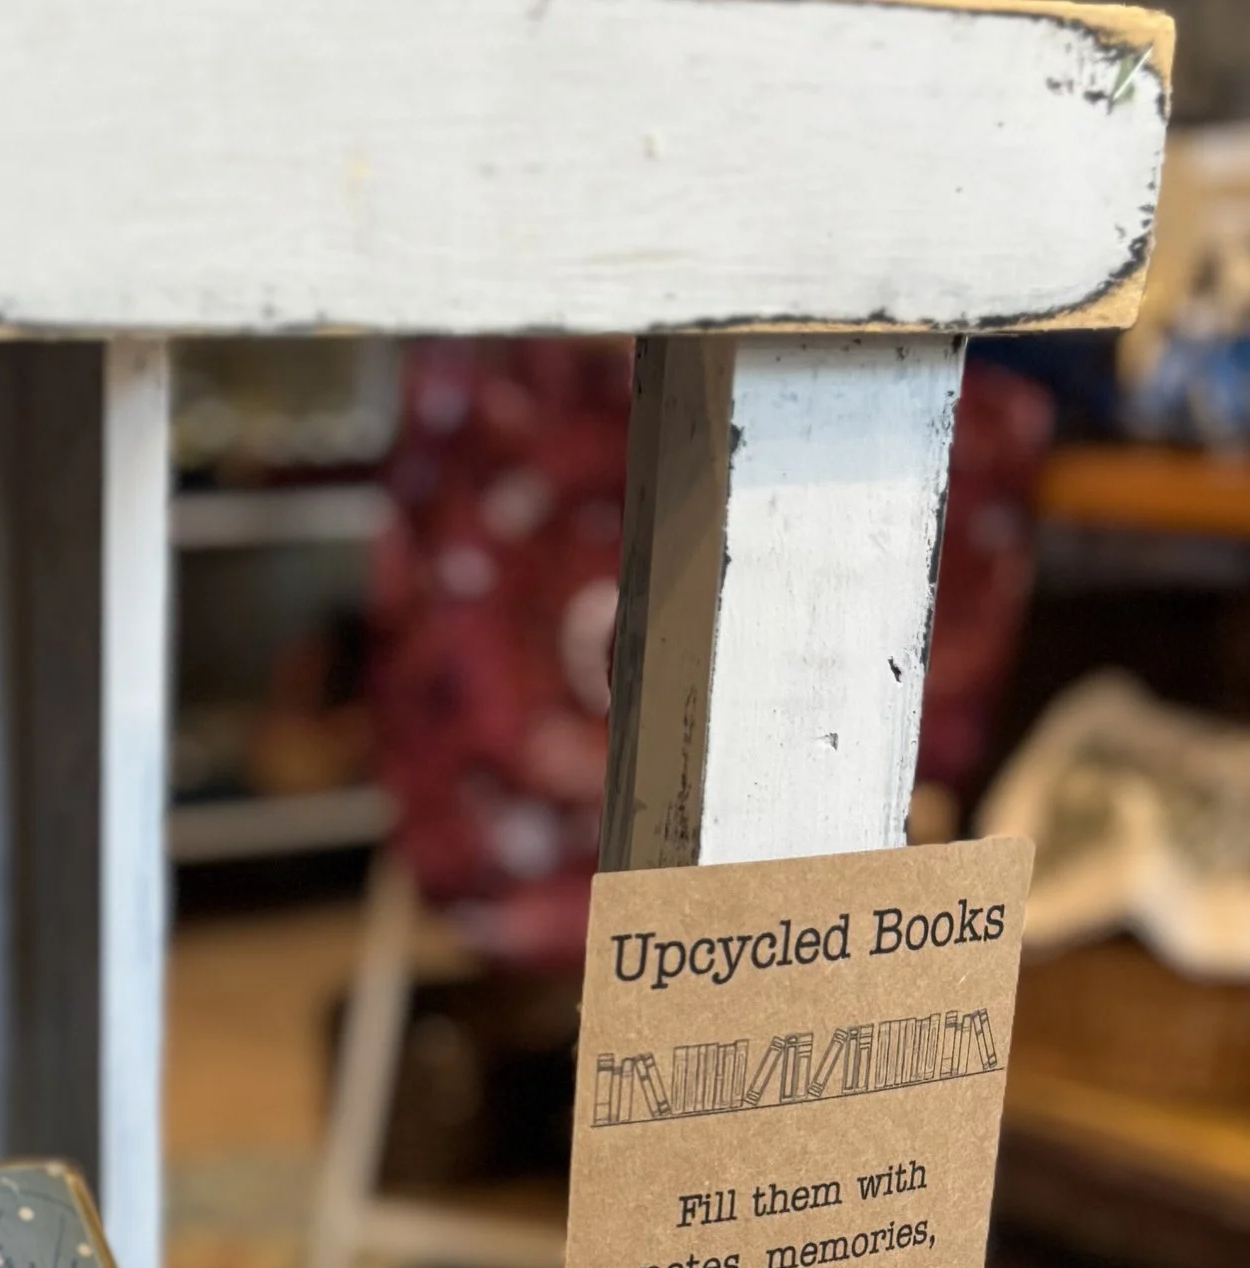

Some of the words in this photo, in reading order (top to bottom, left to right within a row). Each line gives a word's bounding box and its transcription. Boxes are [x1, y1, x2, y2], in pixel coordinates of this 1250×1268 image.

[611, 913, 851, 990] Upcycled
[869, 899, 1005, 956] Books
[676, 1190, 737, 1228] Fill
[752, 1179, 842, 1218] them
[857, 1160, 926, 1199] with
